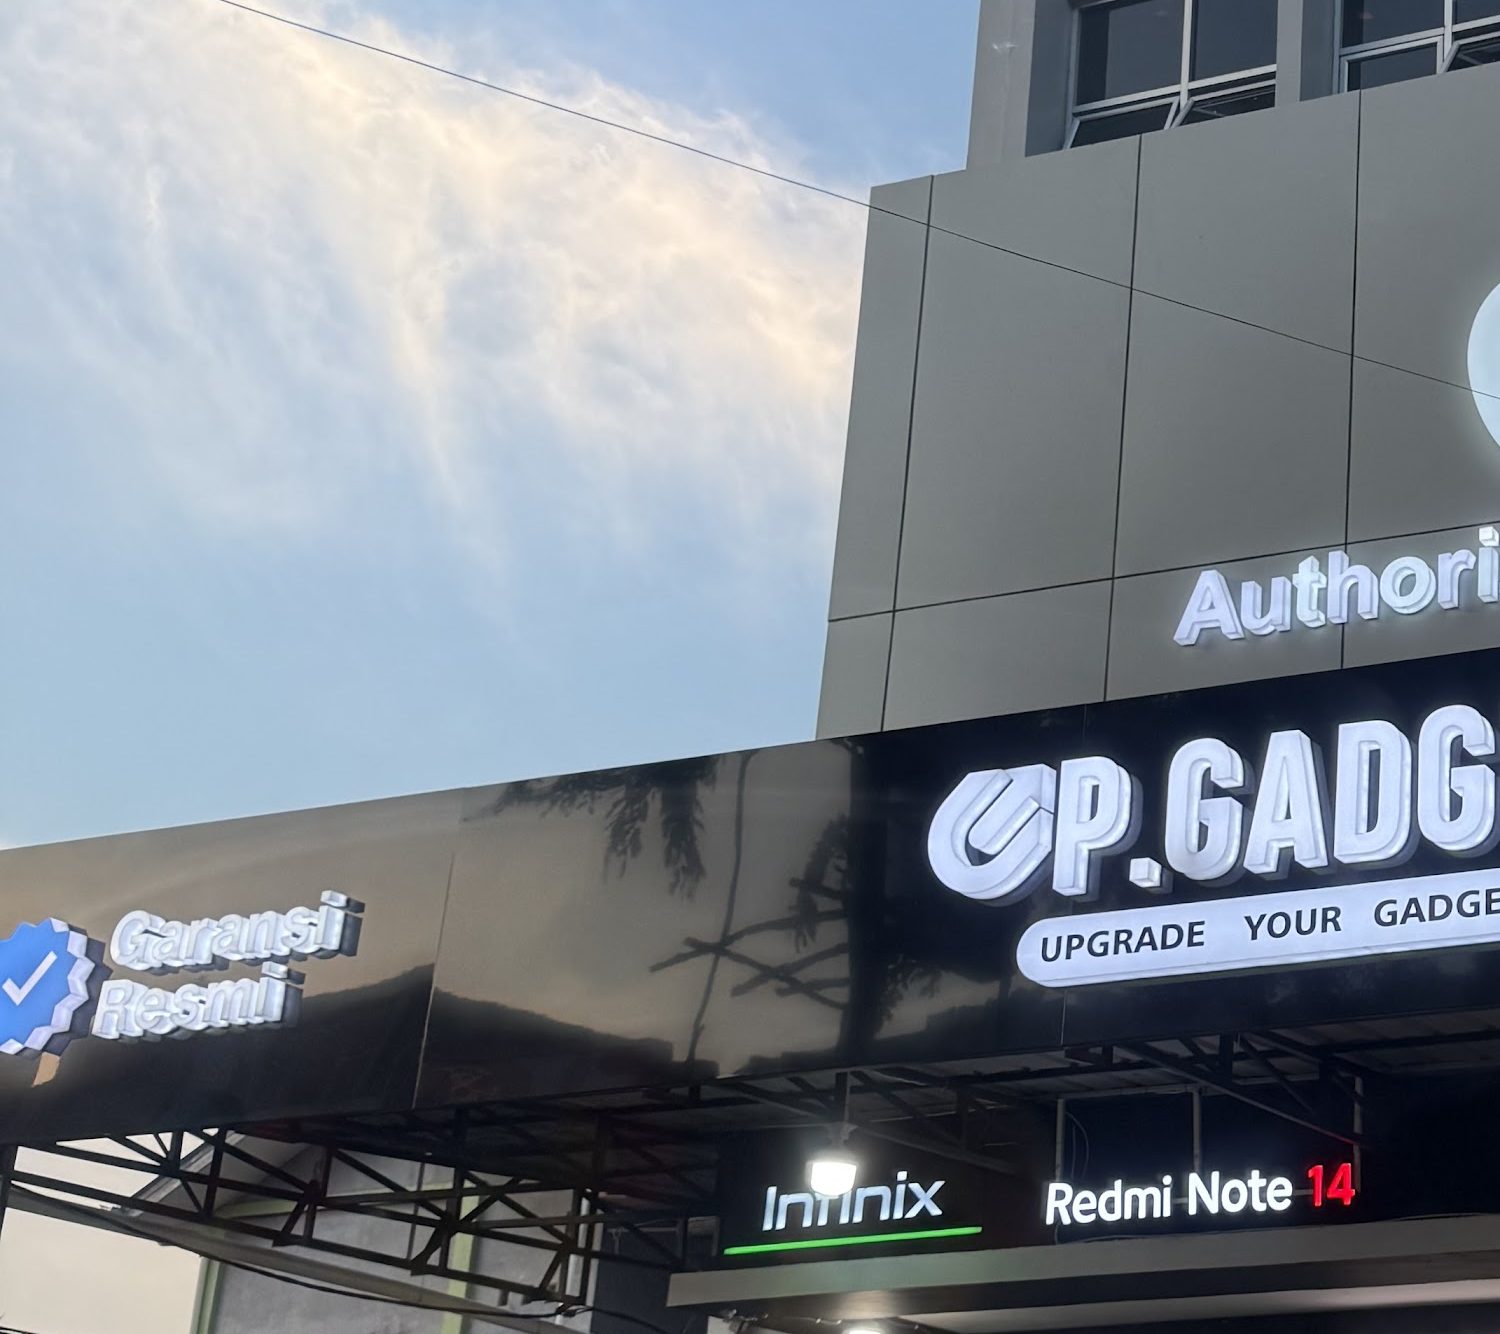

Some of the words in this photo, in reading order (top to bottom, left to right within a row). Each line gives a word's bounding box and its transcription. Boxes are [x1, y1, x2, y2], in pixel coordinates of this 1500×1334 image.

[110, 890, 349, 971] Garansi
[1040, 920, 1206, 963] UPGRADE
[1244, 906, 1343, 942] YOUR
[91, 961, 288, 1040] Resmi
[1045, 1175, 1173, 1226] Redmi
[1187, 1169, 1293, 1218] Note
[1306, 1162, 1356, 1209] 14
